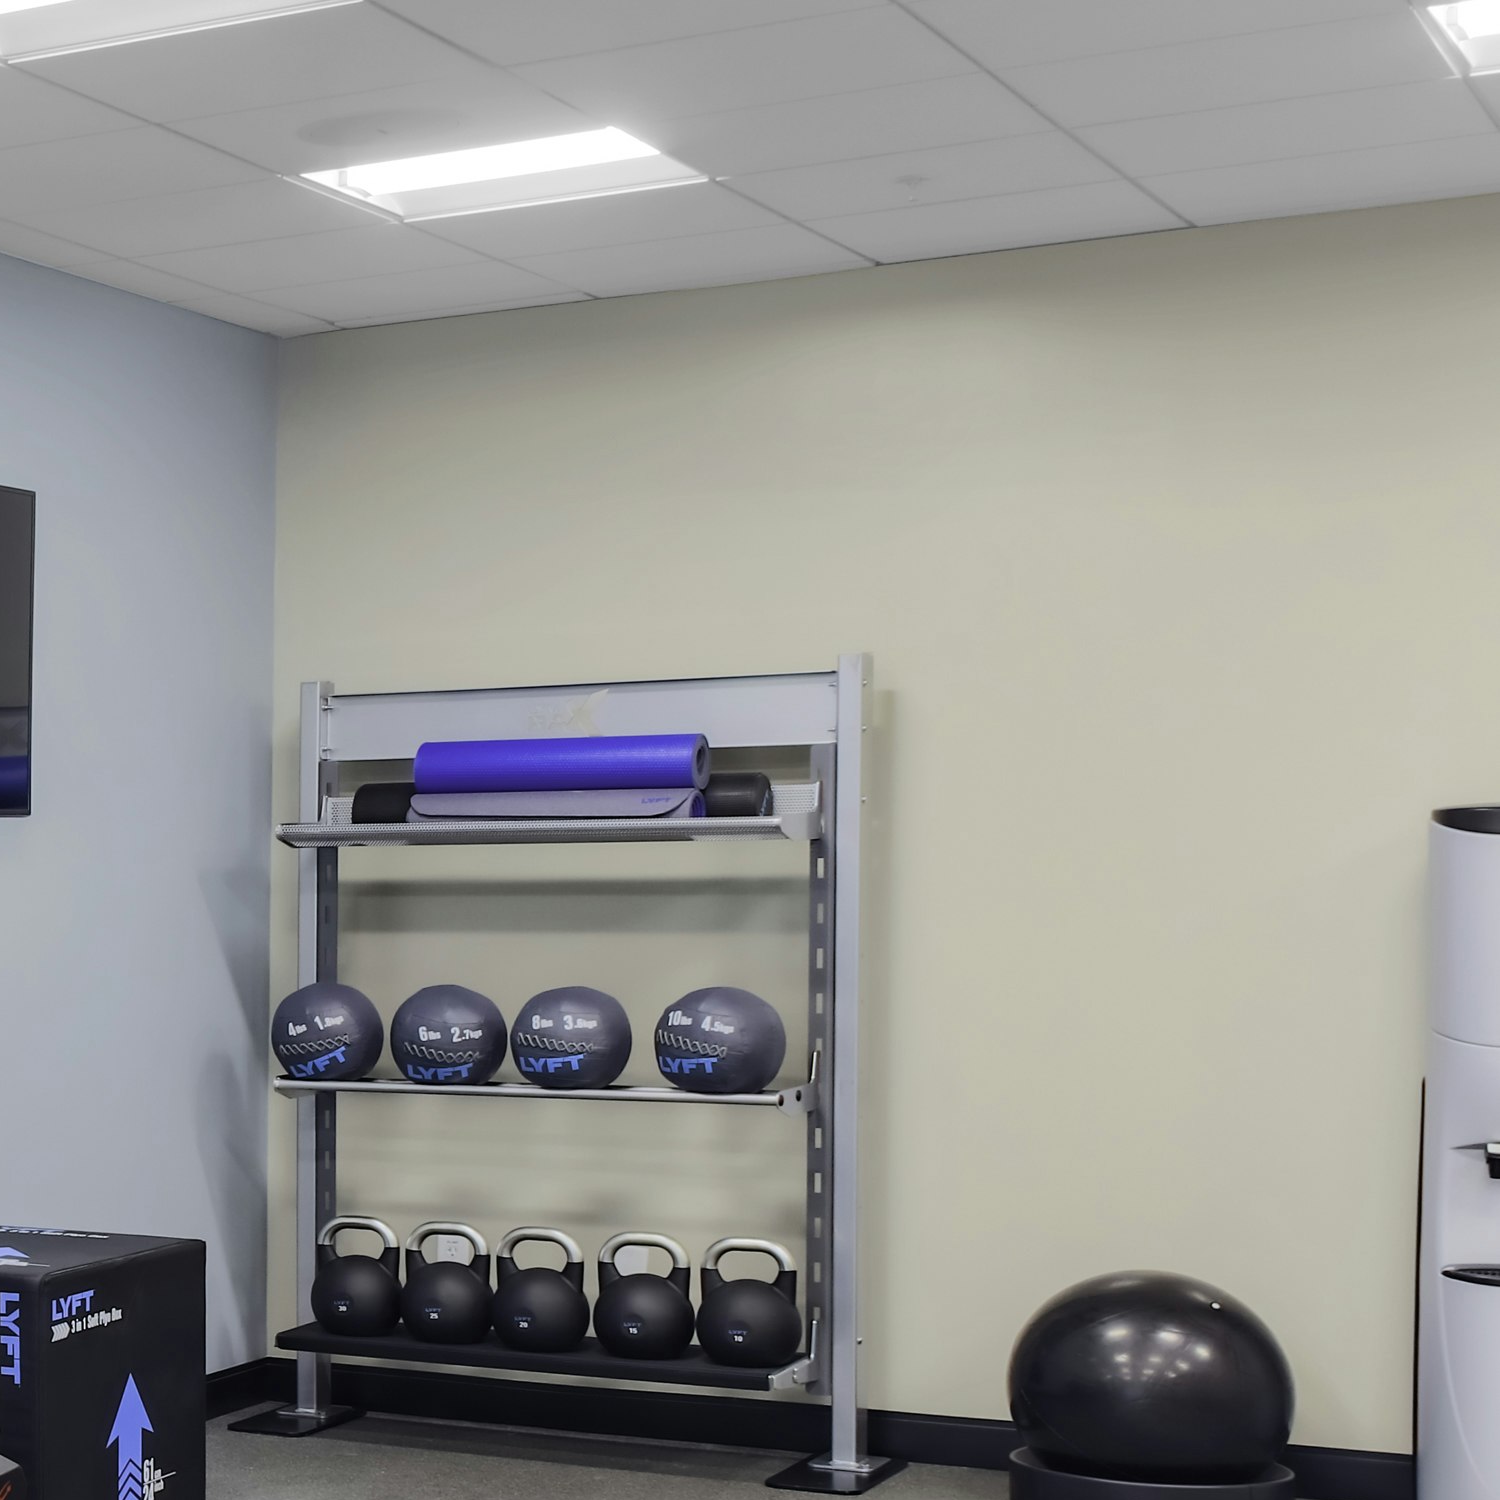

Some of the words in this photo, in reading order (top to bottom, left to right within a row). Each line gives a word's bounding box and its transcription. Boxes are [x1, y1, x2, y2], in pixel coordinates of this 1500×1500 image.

[290, 1046, 346, 1078] LYFT
[407, 1063, 473, 1080] LYFT
[520, 1054, 584, 1072] LYFT
[659, 1056, 717, 1073] LYFT
[52, 1289, 95, 1321] LYFT
[0, 1292, 20, 1384] LYFT
